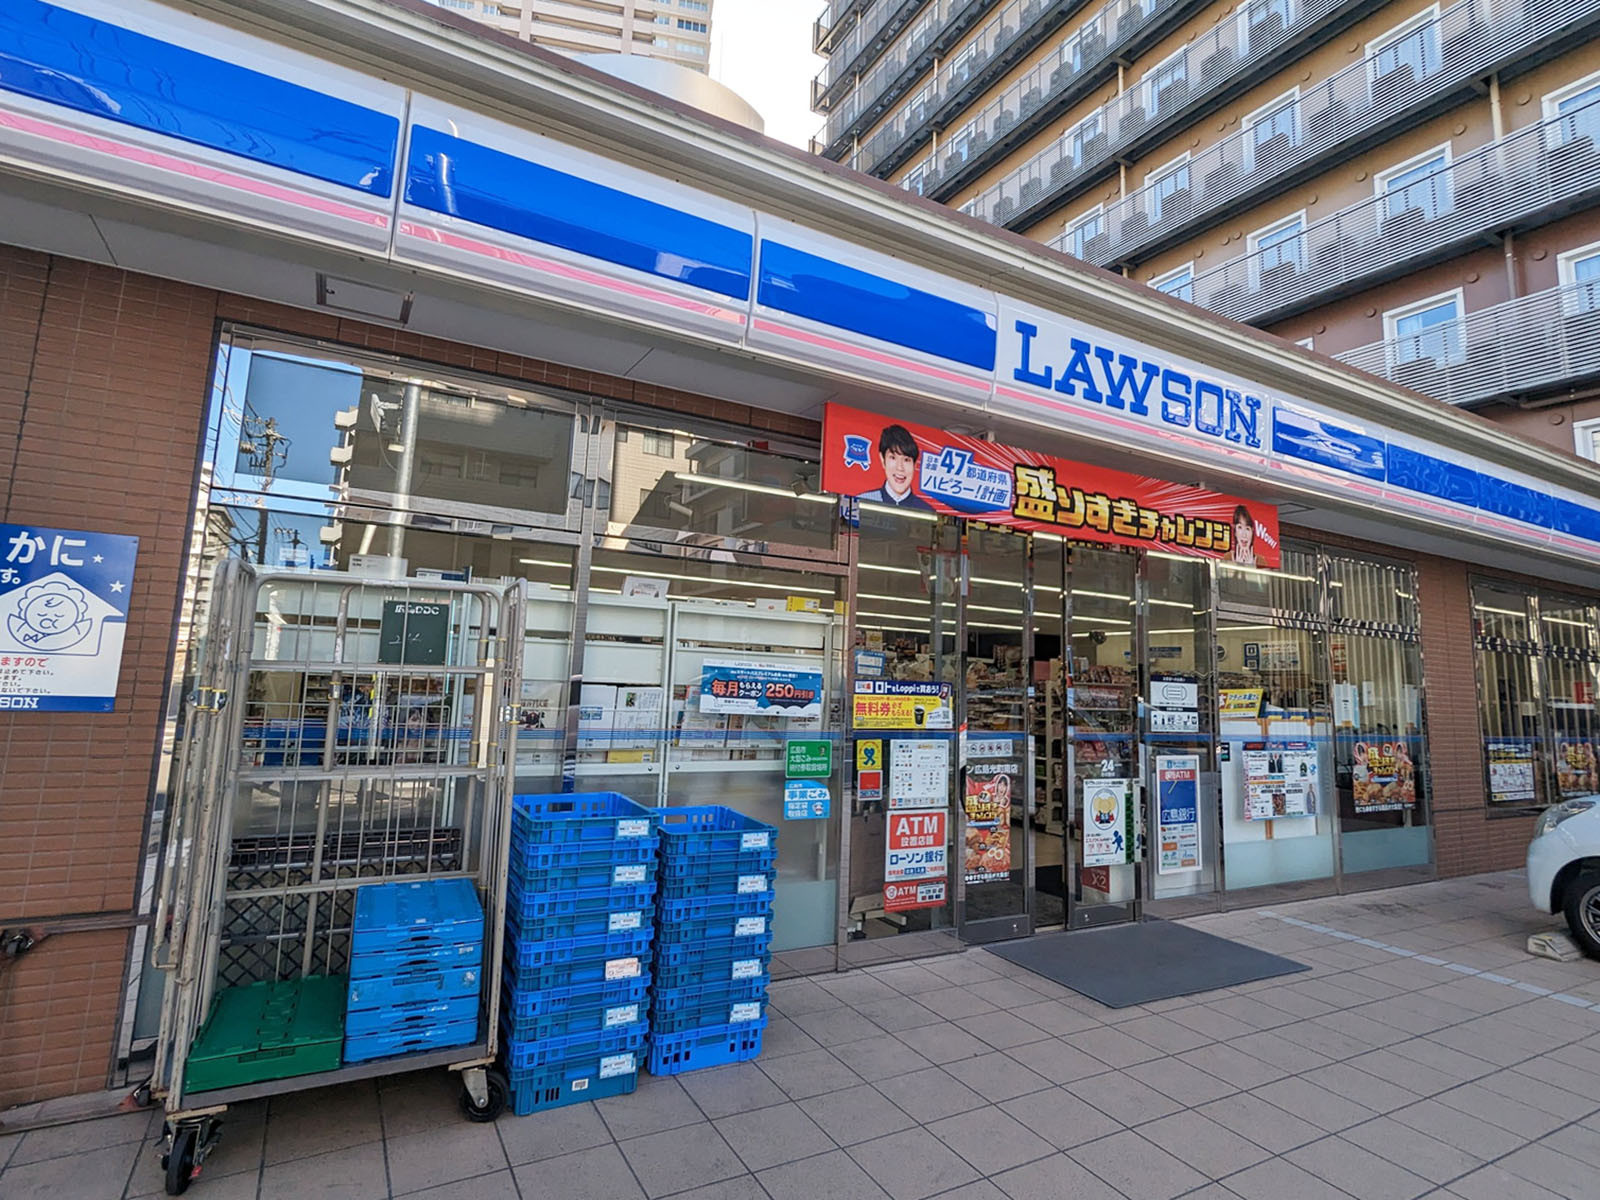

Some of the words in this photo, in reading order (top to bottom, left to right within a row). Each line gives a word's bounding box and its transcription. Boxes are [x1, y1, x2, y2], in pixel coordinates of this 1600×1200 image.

[1013, 319, 1263, 449] LAWSON
[940, 450, 968, 476] 47
[966, 466, 1008, 485] 都道府県
[923, 475, 1009, 504] ハピろー!計画
[1013, 463, 1232, 552] 盛りすぎチャレンジ
[6, 531, 87, 566] かに
[1, 656, 50, 668] ますので
[712, 680, 739, 697] 毎月
[855, 701, 891, 717] 無料券
[1101, 760, 1115, 772] 24
[896, 816, 938, 836] ATM
[890, 850, 943, 865] ローソン銀行
[897, 886, 917, 896] ATM
